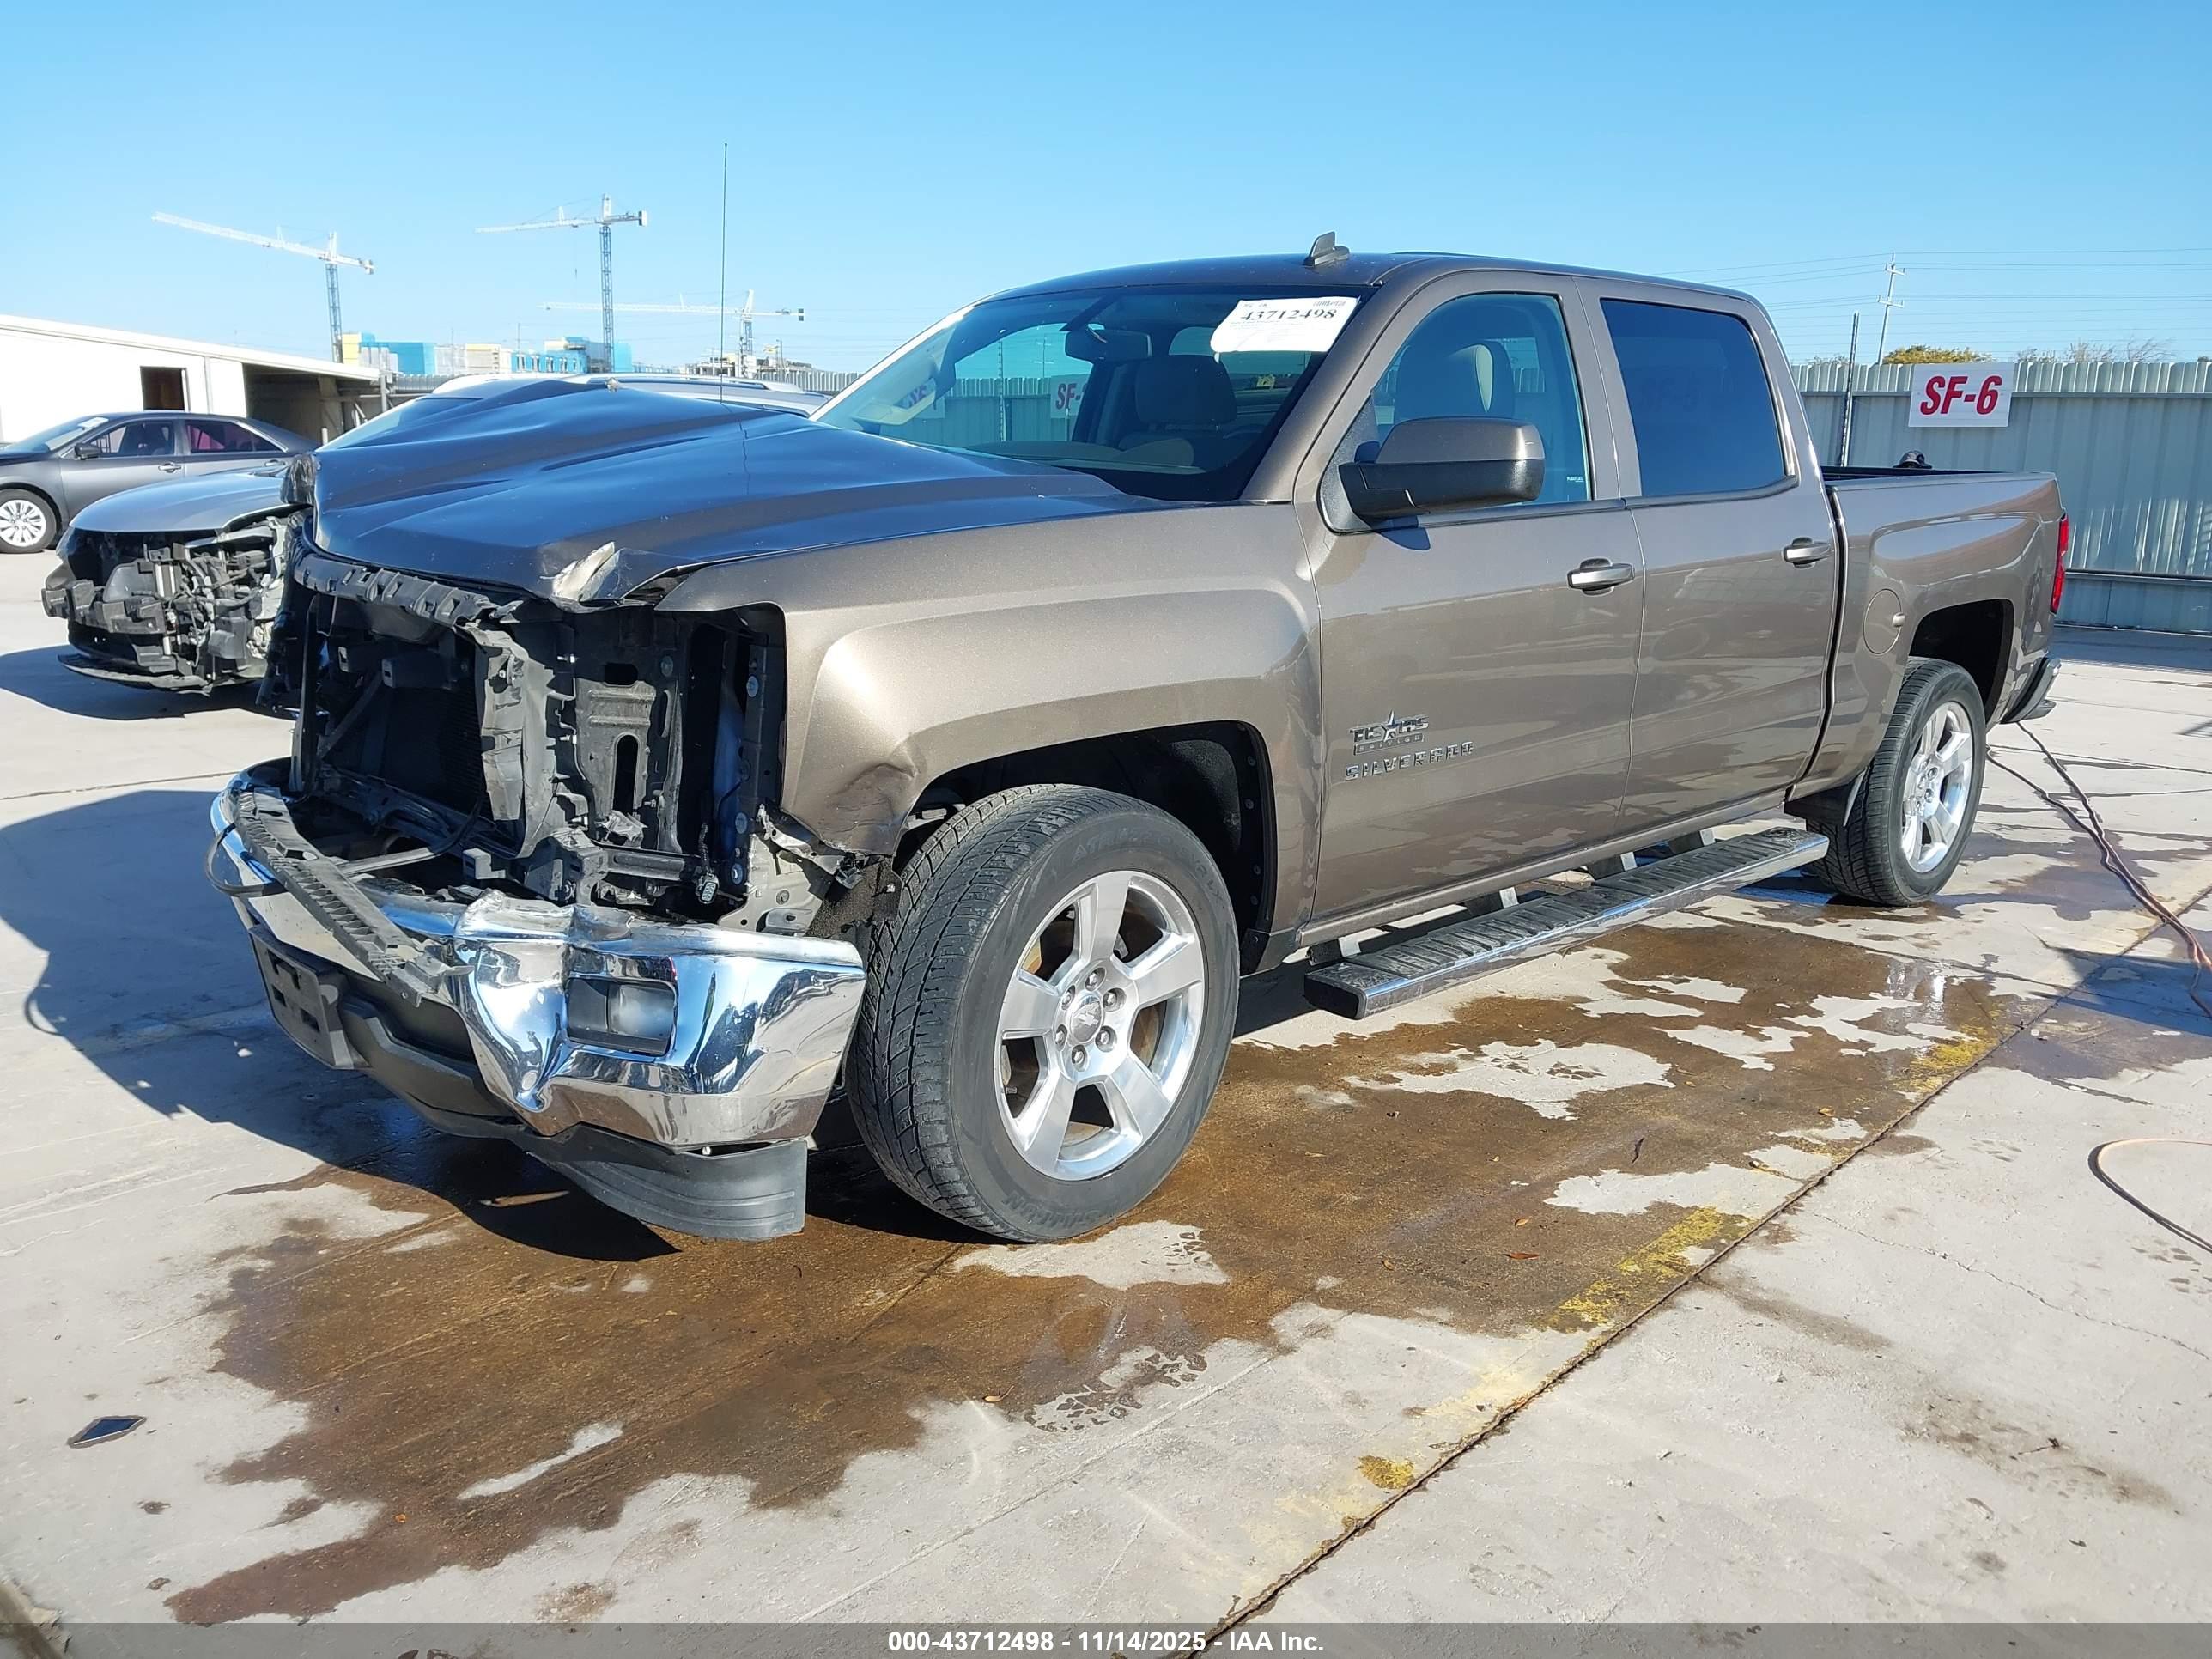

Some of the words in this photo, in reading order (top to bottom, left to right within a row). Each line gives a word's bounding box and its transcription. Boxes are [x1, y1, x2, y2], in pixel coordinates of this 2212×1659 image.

[1240, 308, 1337, 321] 43712498
[1055, 383, 1086, 410] SF-
[1919, 375, 2002, 415] SF-6
[1349, 711, 1429, 743] TEXAS
[1346, 741, 1474, 781] SILVERADO
